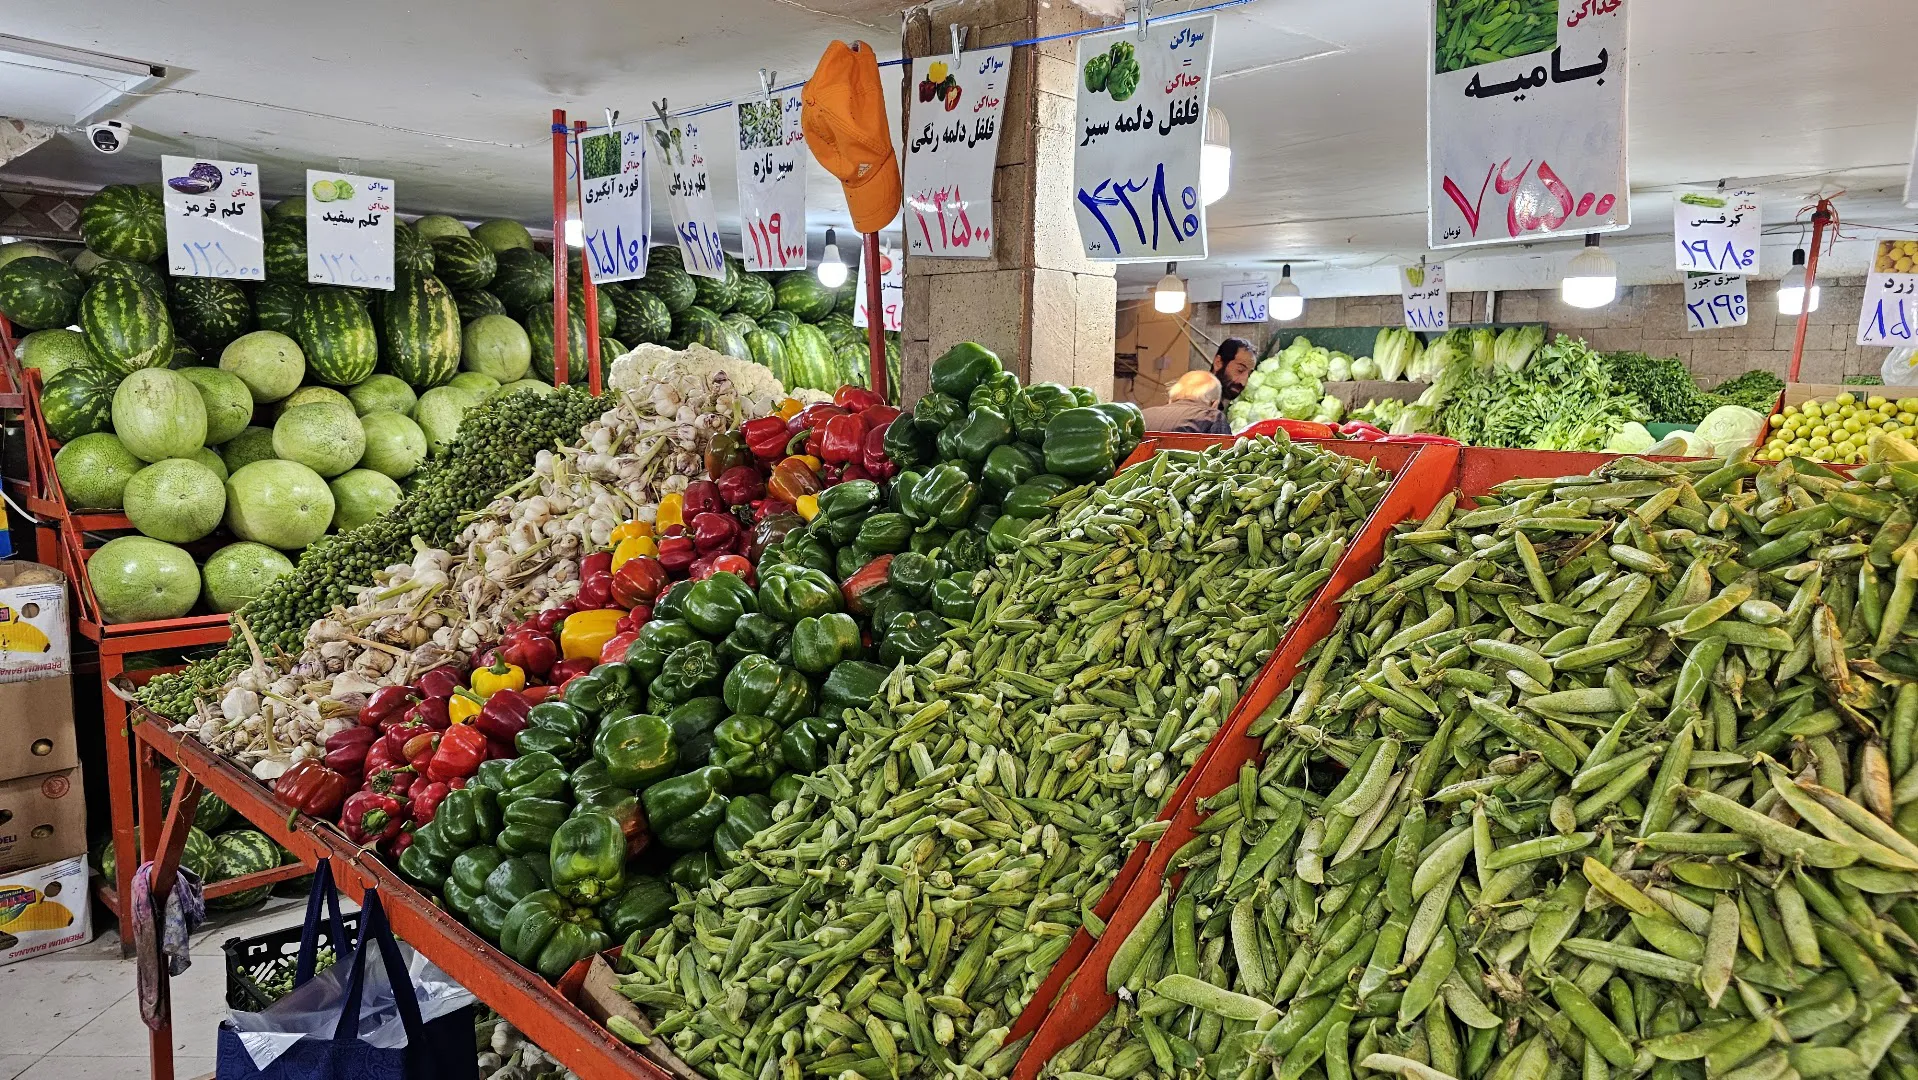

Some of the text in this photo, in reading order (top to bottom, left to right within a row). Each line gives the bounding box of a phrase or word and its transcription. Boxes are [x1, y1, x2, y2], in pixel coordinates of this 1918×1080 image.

[1566, 0, 1623, 28] جداکن
[1170, 27, 1204, 50] سواکن
[979, 55, 1004, 75] سواکن
[1464, 45, 1609, 102] بامیه
[1165, 72, 1202, 95] جداکن
[785, 97, 803, 112] سواکن
[973, 95, 1000, 113] جداکن
[1080, 95, 1200, 147] فلفل دلمه سبز
[623, 132, 640, 145] سواکن
[785, 130, 804, 146] جداکن
[911, 115, 995, 153] فلفل دلمه رنگی
[230, 167, 252, 177] سواکن
[623, 160, 640, 175] جداکن
[753, 152, 773, 183] تازه
[231, 188, 255, 199] جداکن
[367, 182, 389, 192] سواکن
[585, 174, 639, 204] قوره آبگیری
[668, 172, 706, 197] کلم بروکلی
[183, 198, 246, 219] کلم قرمز
[367, 202, 390, 213] جداکن
[322, 210, 382, 229] کلم سفید
[1690, 212, 1744, 228] کرفس
[1443, 226, 1461, 240] تومان
[1088, 241, 1101, 251] تومان
[183, 241, 259, 277] ۱۲۵۰۰
[1691, 274, 1741, 290] سبزی جور
[1884, 277, 1914, 294] زرد
[1427, 288, 1440, 300] کاهو
[8, 932, 85, 959] PREMIUM BANANAS
